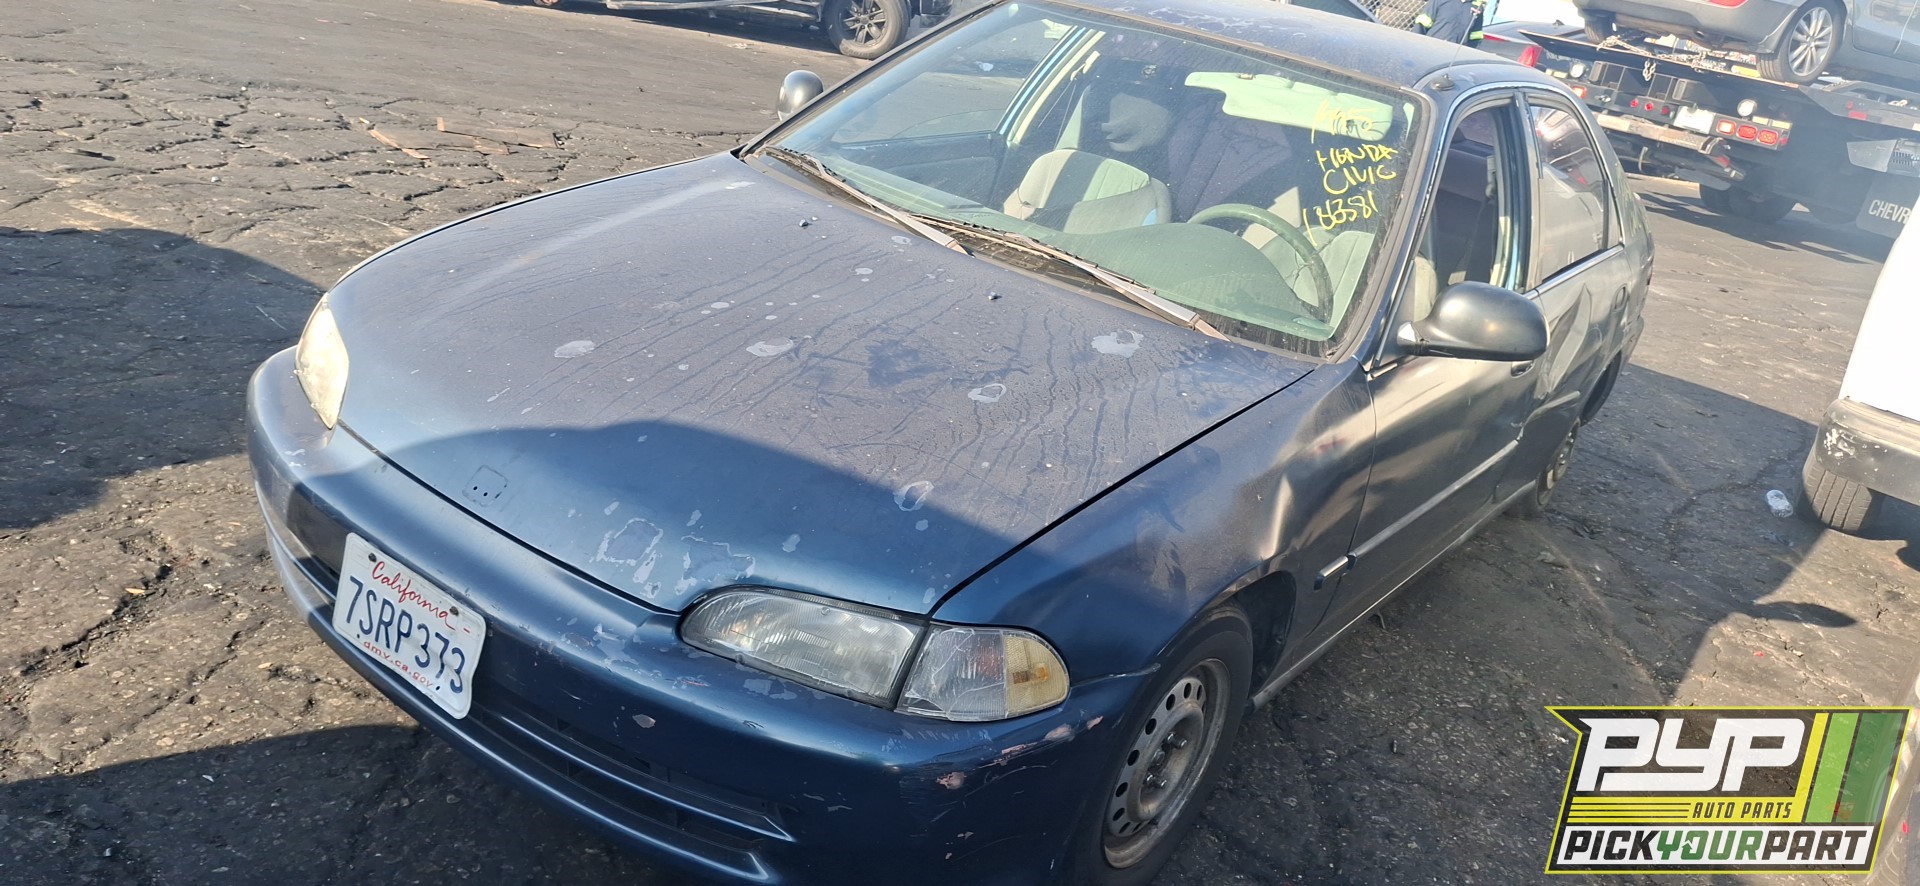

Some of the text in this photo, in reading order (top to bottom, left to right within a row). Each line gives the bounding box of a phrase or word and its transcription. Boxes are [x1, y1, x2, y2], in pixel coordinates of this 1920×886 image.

[1316, 143, 1398, 172] HONDA
[1323, 165, 1396, 194] CIVIC
[371, 561, 457, 631] California
[346, 575, 466, 694] 7SRP373
[363, 640, 434, 689] dmv.ca.gov
